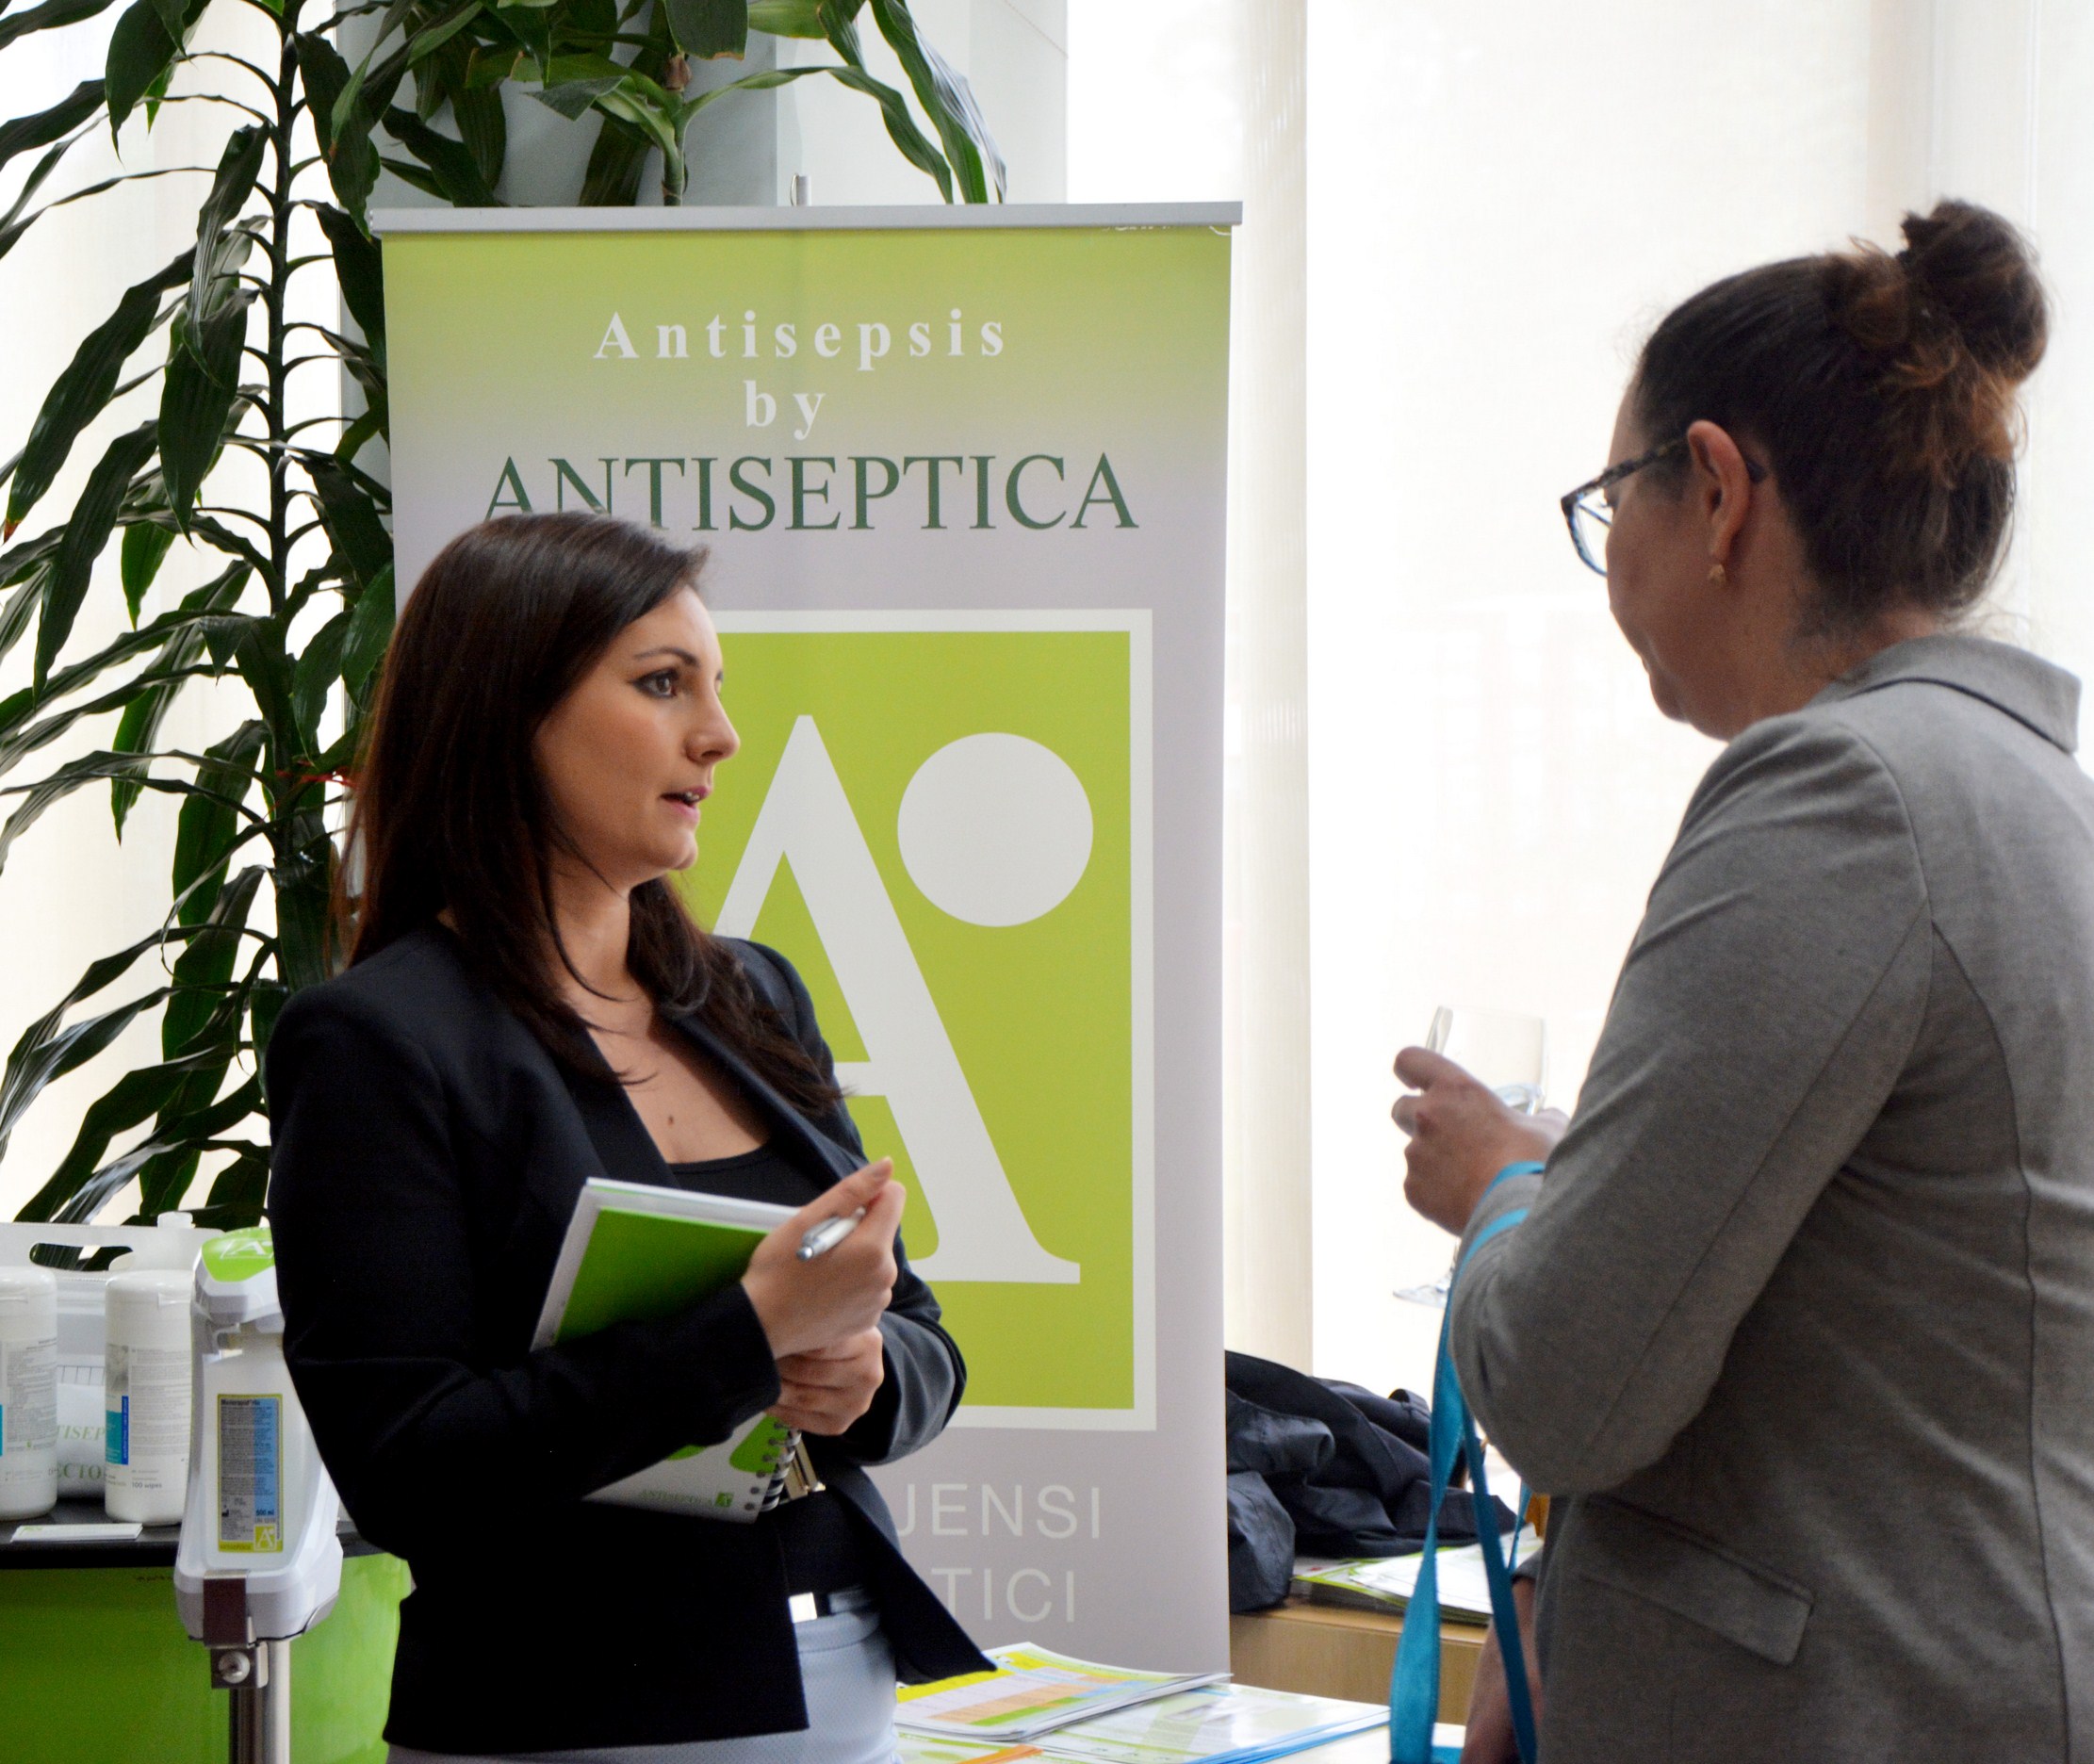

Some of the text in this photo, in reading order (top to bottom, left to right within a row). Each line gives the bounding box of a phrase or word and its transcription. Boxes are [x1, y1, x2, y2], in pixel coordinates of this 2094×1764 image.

[594, 309, 1005, 371] Antisepsis
[744, 381, 825, 440] by
[485, 452, 1138, 531] ANTISEPTICA
[897, 1483, 1101, 1539] JENSI
[931, 1567, 1075, 1623] TICI
